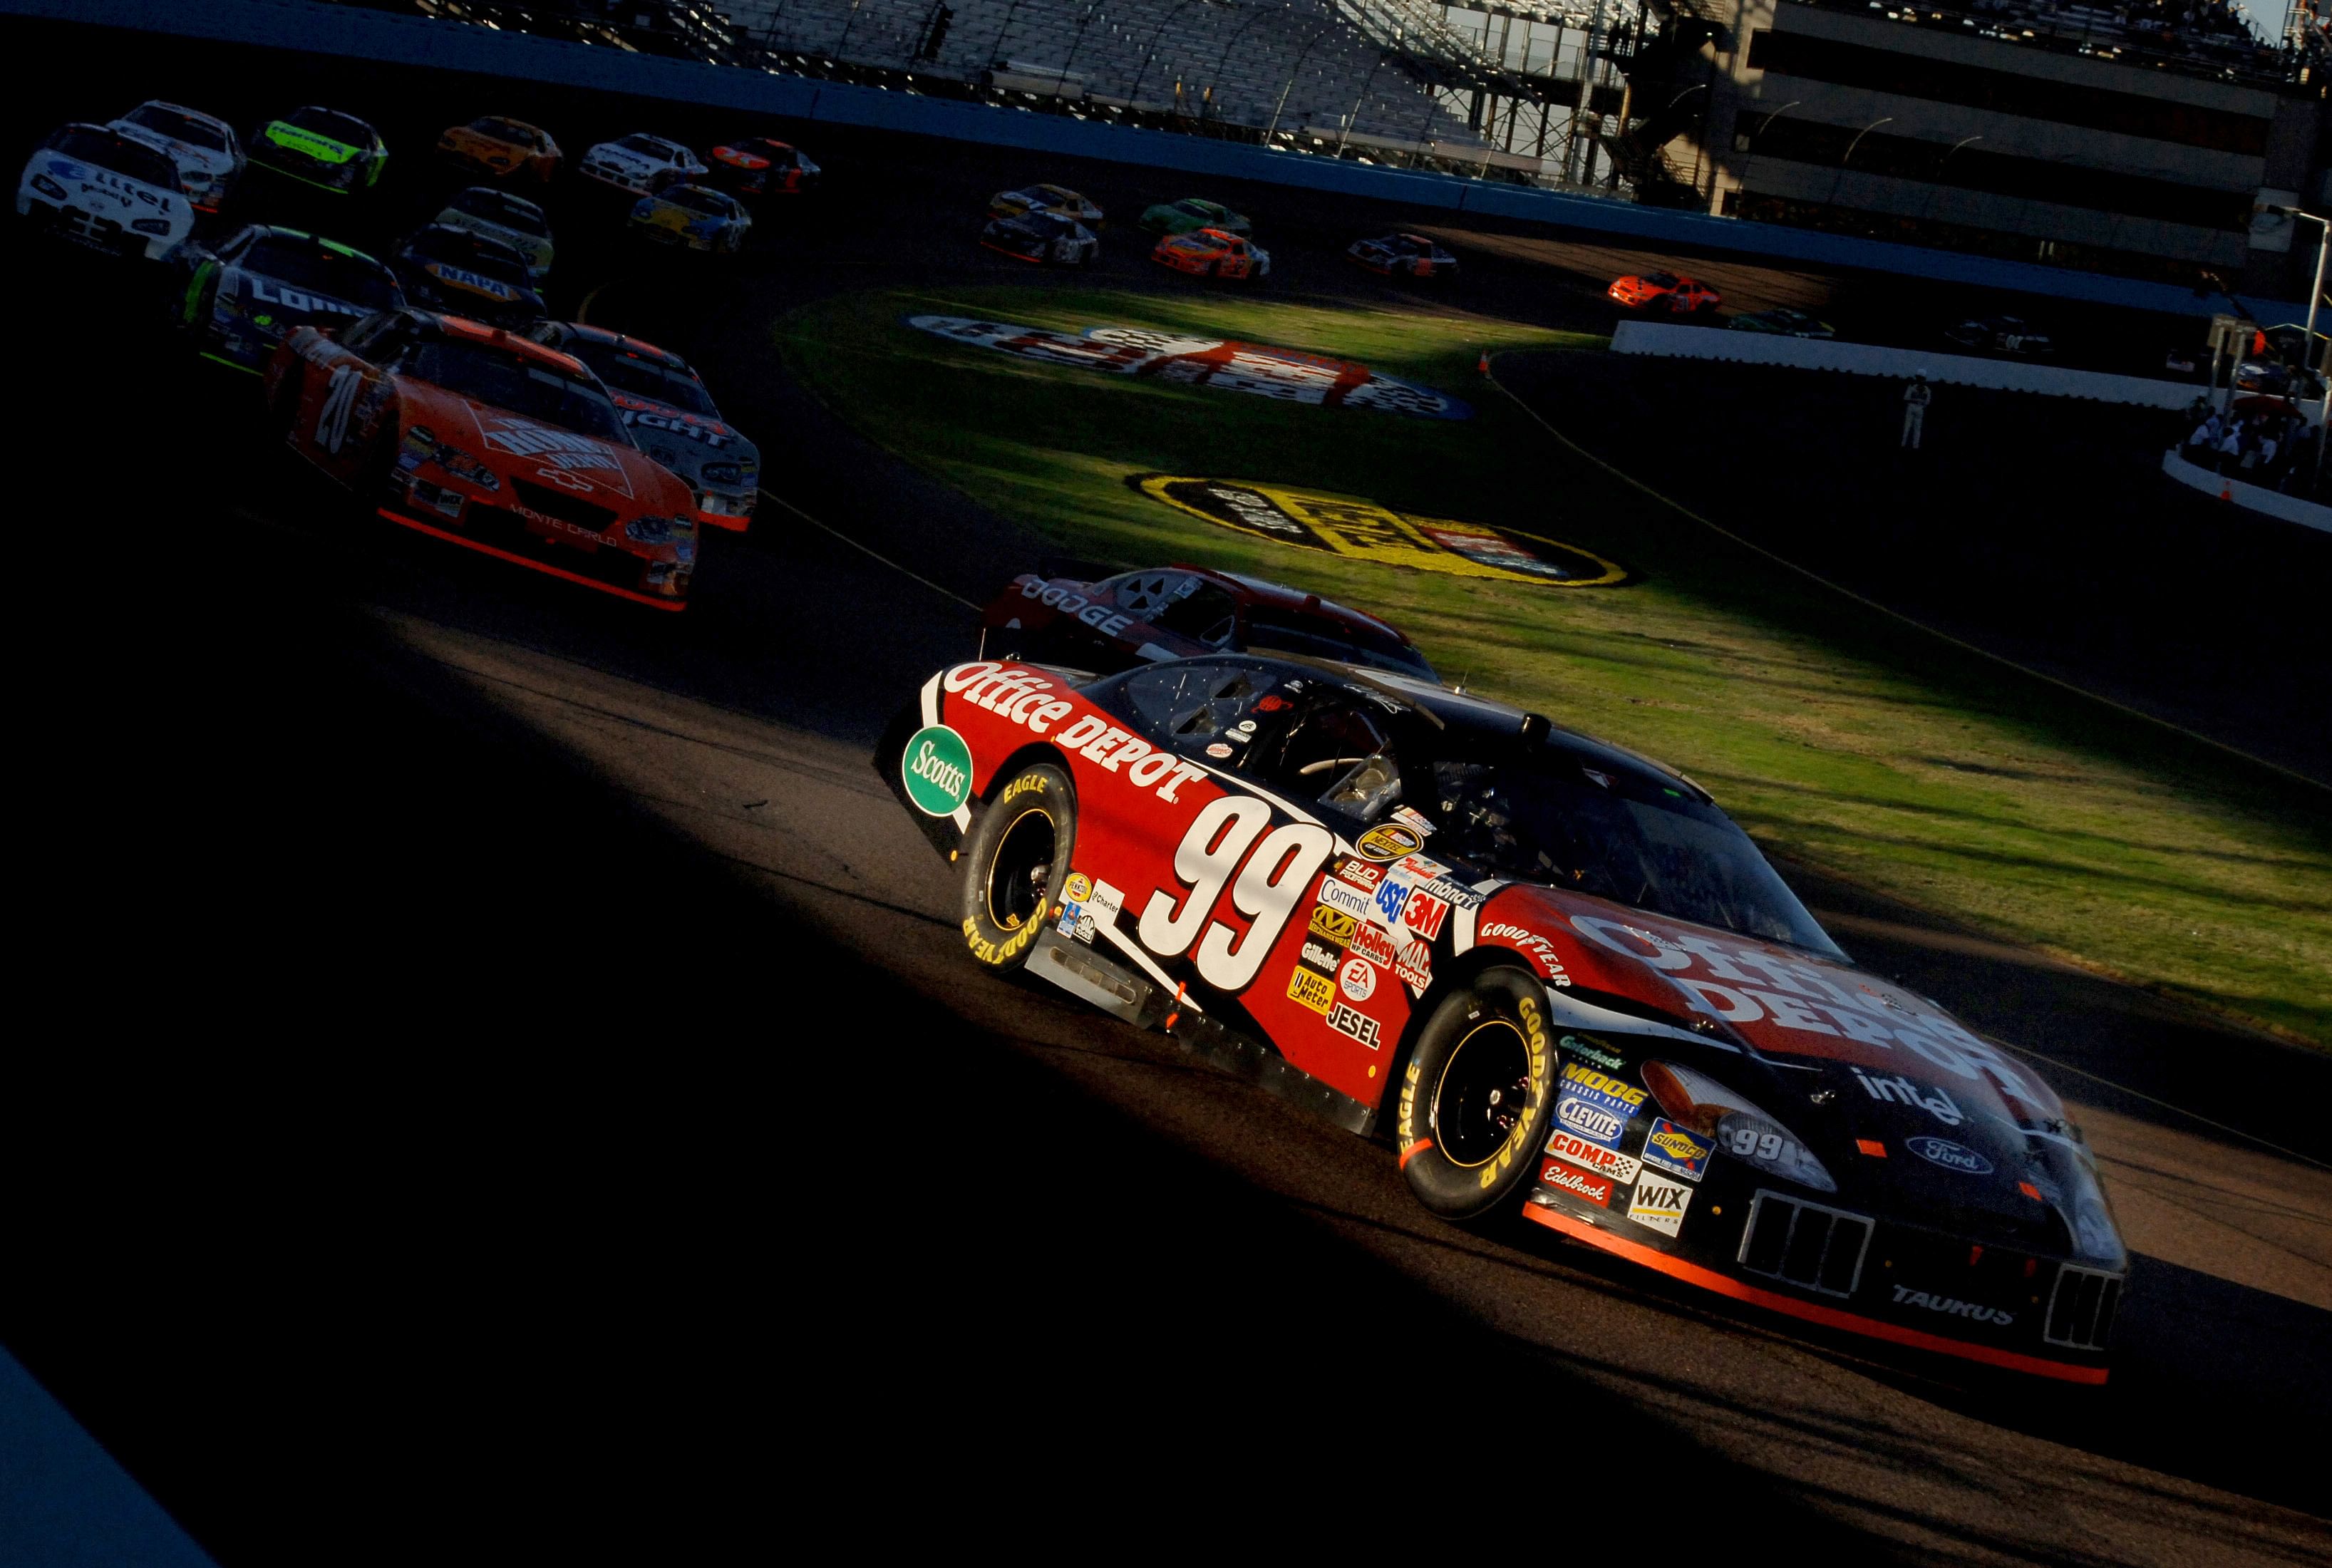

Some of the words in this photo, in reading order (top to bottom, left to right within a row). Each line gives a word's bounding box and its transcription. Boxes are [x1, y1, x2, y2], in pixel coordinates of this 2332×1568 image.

[442, 267, 505, 296] NAPA
[315, 365, 363, 454] 20
[622, 411, 733, 448] IGHT
[510, 502, 562, 530] MONTE
[567, 523, 617, 547] CARLO
[1021, 579, 1135, 637] DODGE
[944, 661, 1073, 733] Office
[1056, 713, 1209, 803] DEPOT
[911, 740, 964, 799] Scotts
[1004, 775, 1048, 803] EAGLE
[1371, 835, 1402, 852] NEXTEL
[1346, 860, 1380, 881] BUD
[1097, 894, 1118, 913] Charter
[1140, 795, 1336, 991] 99
[1321, 879, 1371, 914] Commit
[1376, 879, 1408, 924] USG
[963, 897, 1048, 965] GOODYEAR
[1404, 892, 1448, 941] 3M
[1302, 942, 1338, 972] Gillette
[1335, 935, 1351, 949] WEAR
[1354, 924, 1395, 965] Holley
[1361, 948, 1384, 964] CARBS
[1398, 941, 1430, 976] MAC
[1480, 923, 1572, 987] GOODYEAR
[1304, 976, 1327, 994] Auto
[1344, 980, 1368, 998] SPORTS
[1347, 962, 1368, 989] EA
[1395, 964, 1426, 989] TOOLS
[1570, 915, 2002, 1063] Office
[1299, 986, 1329, 1008] Meter
[1328, 1004, 1380, 1048] JESEL
[1666, 974, 2053, 1112] DEPOT
[1479, 996, 1547, 1189] GOODYEAR
[1560, 1079, 1600, 1100] CHASSIS
[1604, 1097, 1635, 1113] PARTS
[1561, 1062, 1649, 1105] MOOG
[1850, 1066, 1964, 1126] intel
[1398, 1061, 1420, 1155] EAGLE
[1559, 1098, 1618, 1136] CLEVITE
[1552, 1134, 1616, 1166] COMP
[1653, 1133, 1707, 1158] SUNOCO
[1732, 1129, 1783, 1161] 99
[1924, 1140, 1978, 1170] Ford
[1544, 1165, 1604, 1201] Edelbrock
[1592, 1162, 1624, 1178] CAMS
[1638, 1185, 1686, 1209] WIX
[1629, 1213, 1678, 1224] FILTERS
[1892, 1284, 2016, 1326] TAURUS
